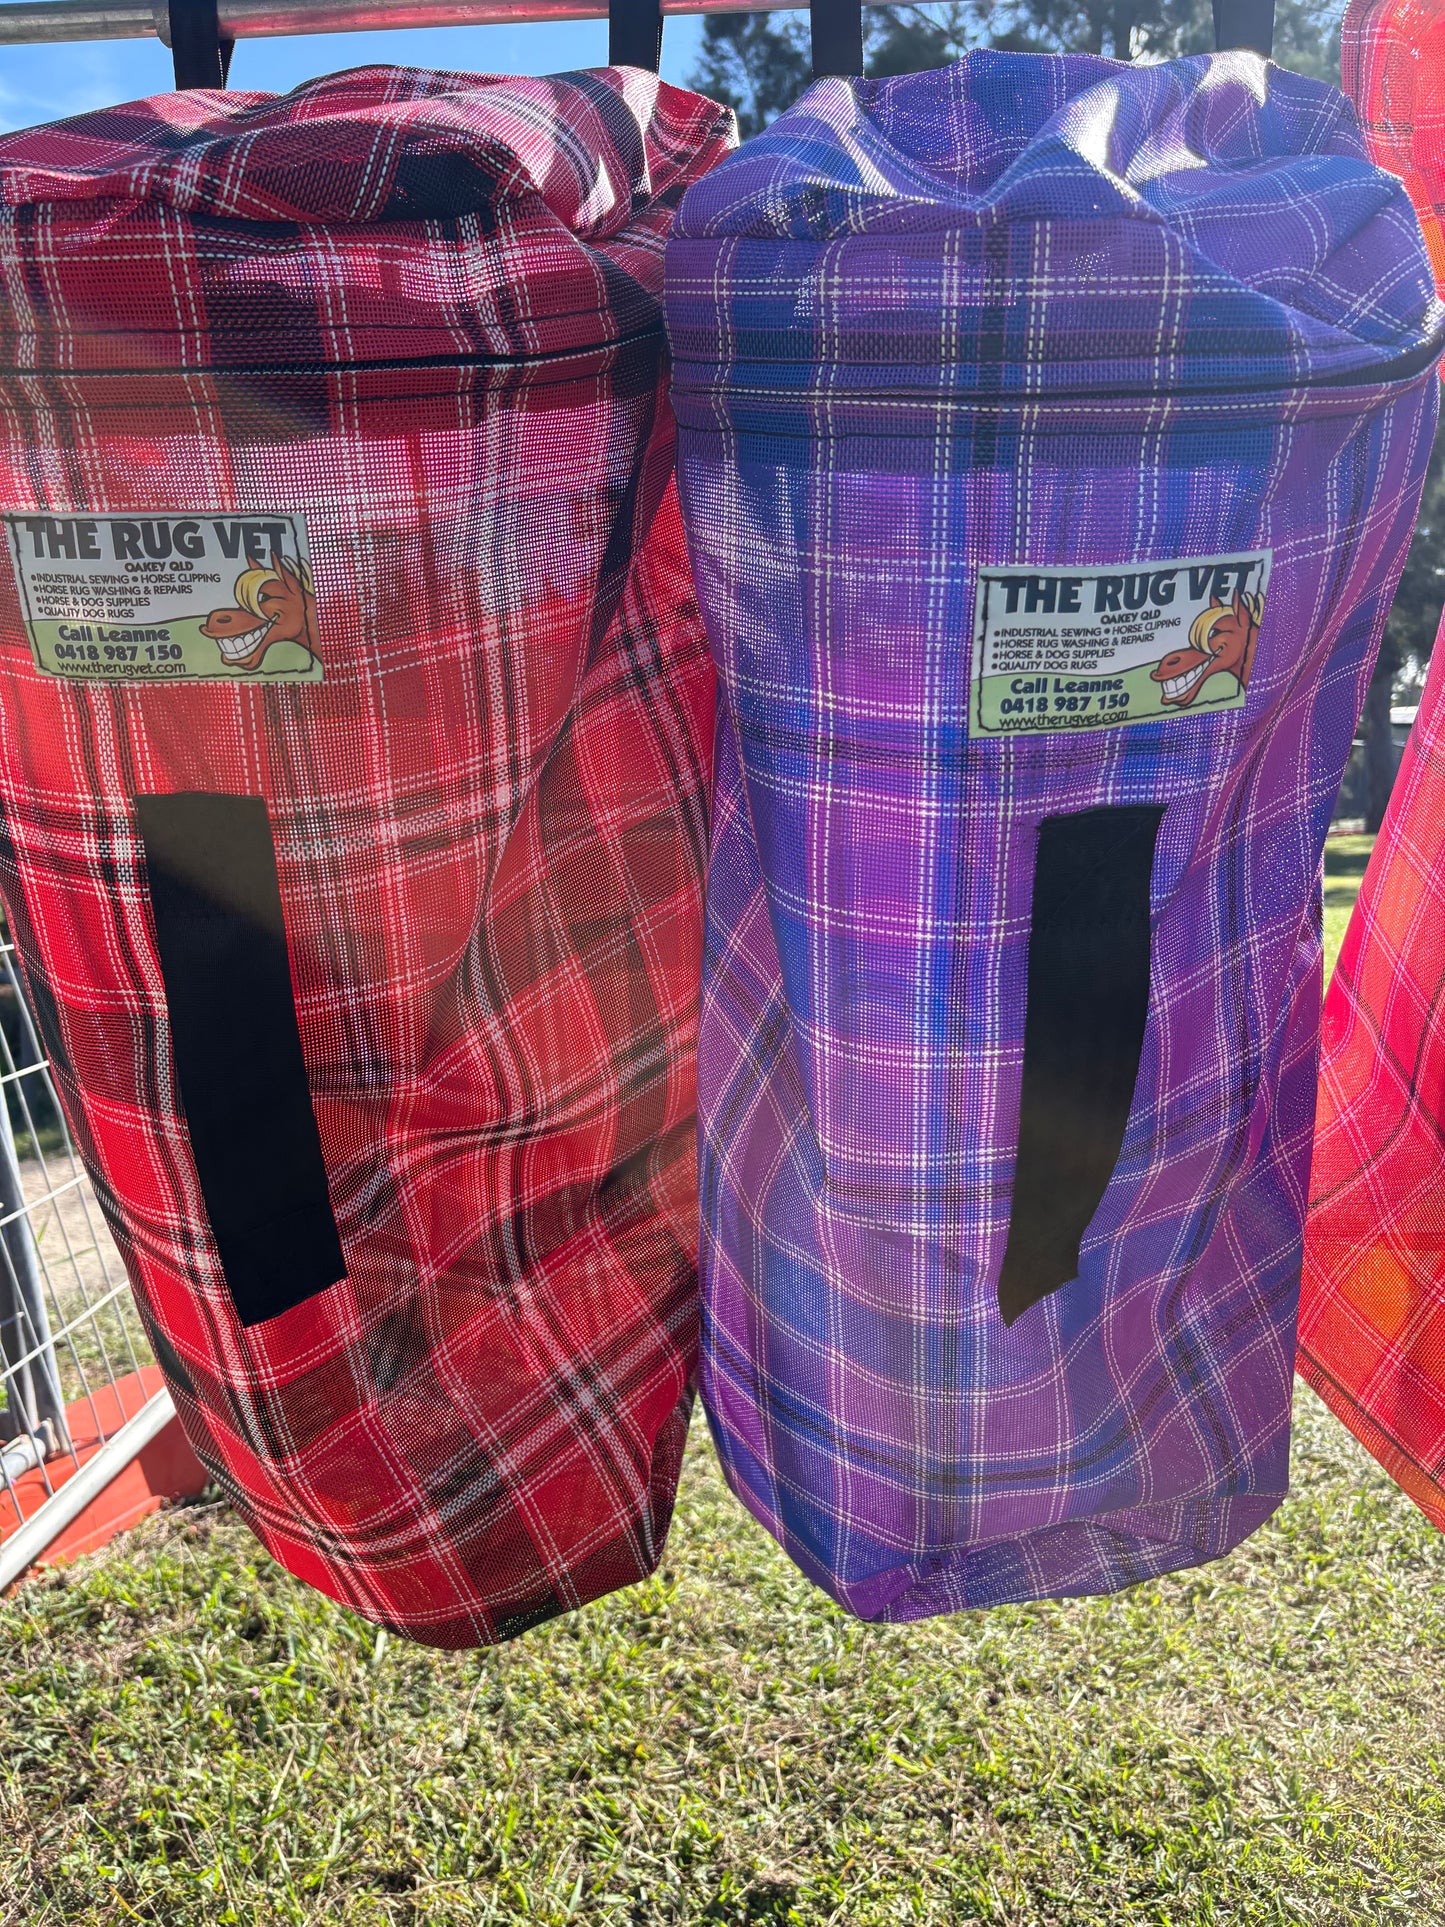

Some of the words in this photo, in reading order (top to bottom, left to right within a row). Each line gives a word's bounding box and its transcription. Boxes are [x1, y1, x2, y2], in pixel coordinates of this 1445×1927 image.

[26, 521, 101, 559] THE
[111, 522, 206, 561] RUG
[213, 522, 287, 560] VET
[124, 562, 166, 572] OAKEY
[169, 562, 193, 571] QLD
[36, 574, 87, 584] INDUSTRIAL
[89, 574, 129, 584] SEWING
[141, 574, 175, 583] HORSE
[178, 574, 220, 583] CLIPPING
[39, 585, 68, 594] HORSE
[70, 585, 90, 595] RUG
[91, 586, 142, 595] WASHING
[144, 586, 152, 595] &
[154, 585, 192, 594] REPAIRS
[1000, 577, 1083, 614] THE
[1093, 569, 1179, 613] RUG
[1187, 561, 1255, 601] VET
[41, 596, 70, 606] HORSE
[72, 597, 79, 606] &
[81, 597, 104, 607] DOG
[106, 597, 150, 607] SUPPLIES
[44, 607, 80, 618] QUALITY
[82, 608, 105, 618] DOG
[107, 609, 134, 618] RUGS
[1101, 612, 1138, 624] OAKEY
[1141, 609, 1161, 621] QLD
[58, 625, 93, 642] Call
[99, 626, 170, 642] Leanne
[1001, 628, 1059, 638] INDUSTRIAL
[1061, 627, 1101, 637] SEWING
[1112, 622, 1143, 635] HORSE
[1145, 617, 1181, 630] CLIPPING
[1000, 639, 1035, 649] HORSE
[1037, 638, 1058, 648] RUG
[1062, 637, 1109, 648] WASHING
[1111, 637, 1119, 646] &
[1121, 633, 1154, 645] REPAIRS
[55, 644, 99, 660] 0418
[104, 645, 138, 661] 987
[146, 645, 182, 660] 150
[999, 650, 1033, 660] HORSE
[1035, 650, 1043, 659] &
[1045, 649, 1070, 659] DOG
[1072, 648, 1115, 658] SUPPLIES
[58, 661, 186, 676] www.therugvet.com
[999, 661, 1042, 671] QUALITY
[1044, 661, 1068, 670] DOG
[1070, 660, 1097, 670] RUGS
[1010, 678, 1050, 694] Call
[1054, 677, 1124, 693] Leanne
[1000, 697, 1048, 714] 0418
[1054, 695, 1091, 712] 987
[1098, 693, 1130, 710] 150
[999, 710, 1129, 727] www.therugvet.com
